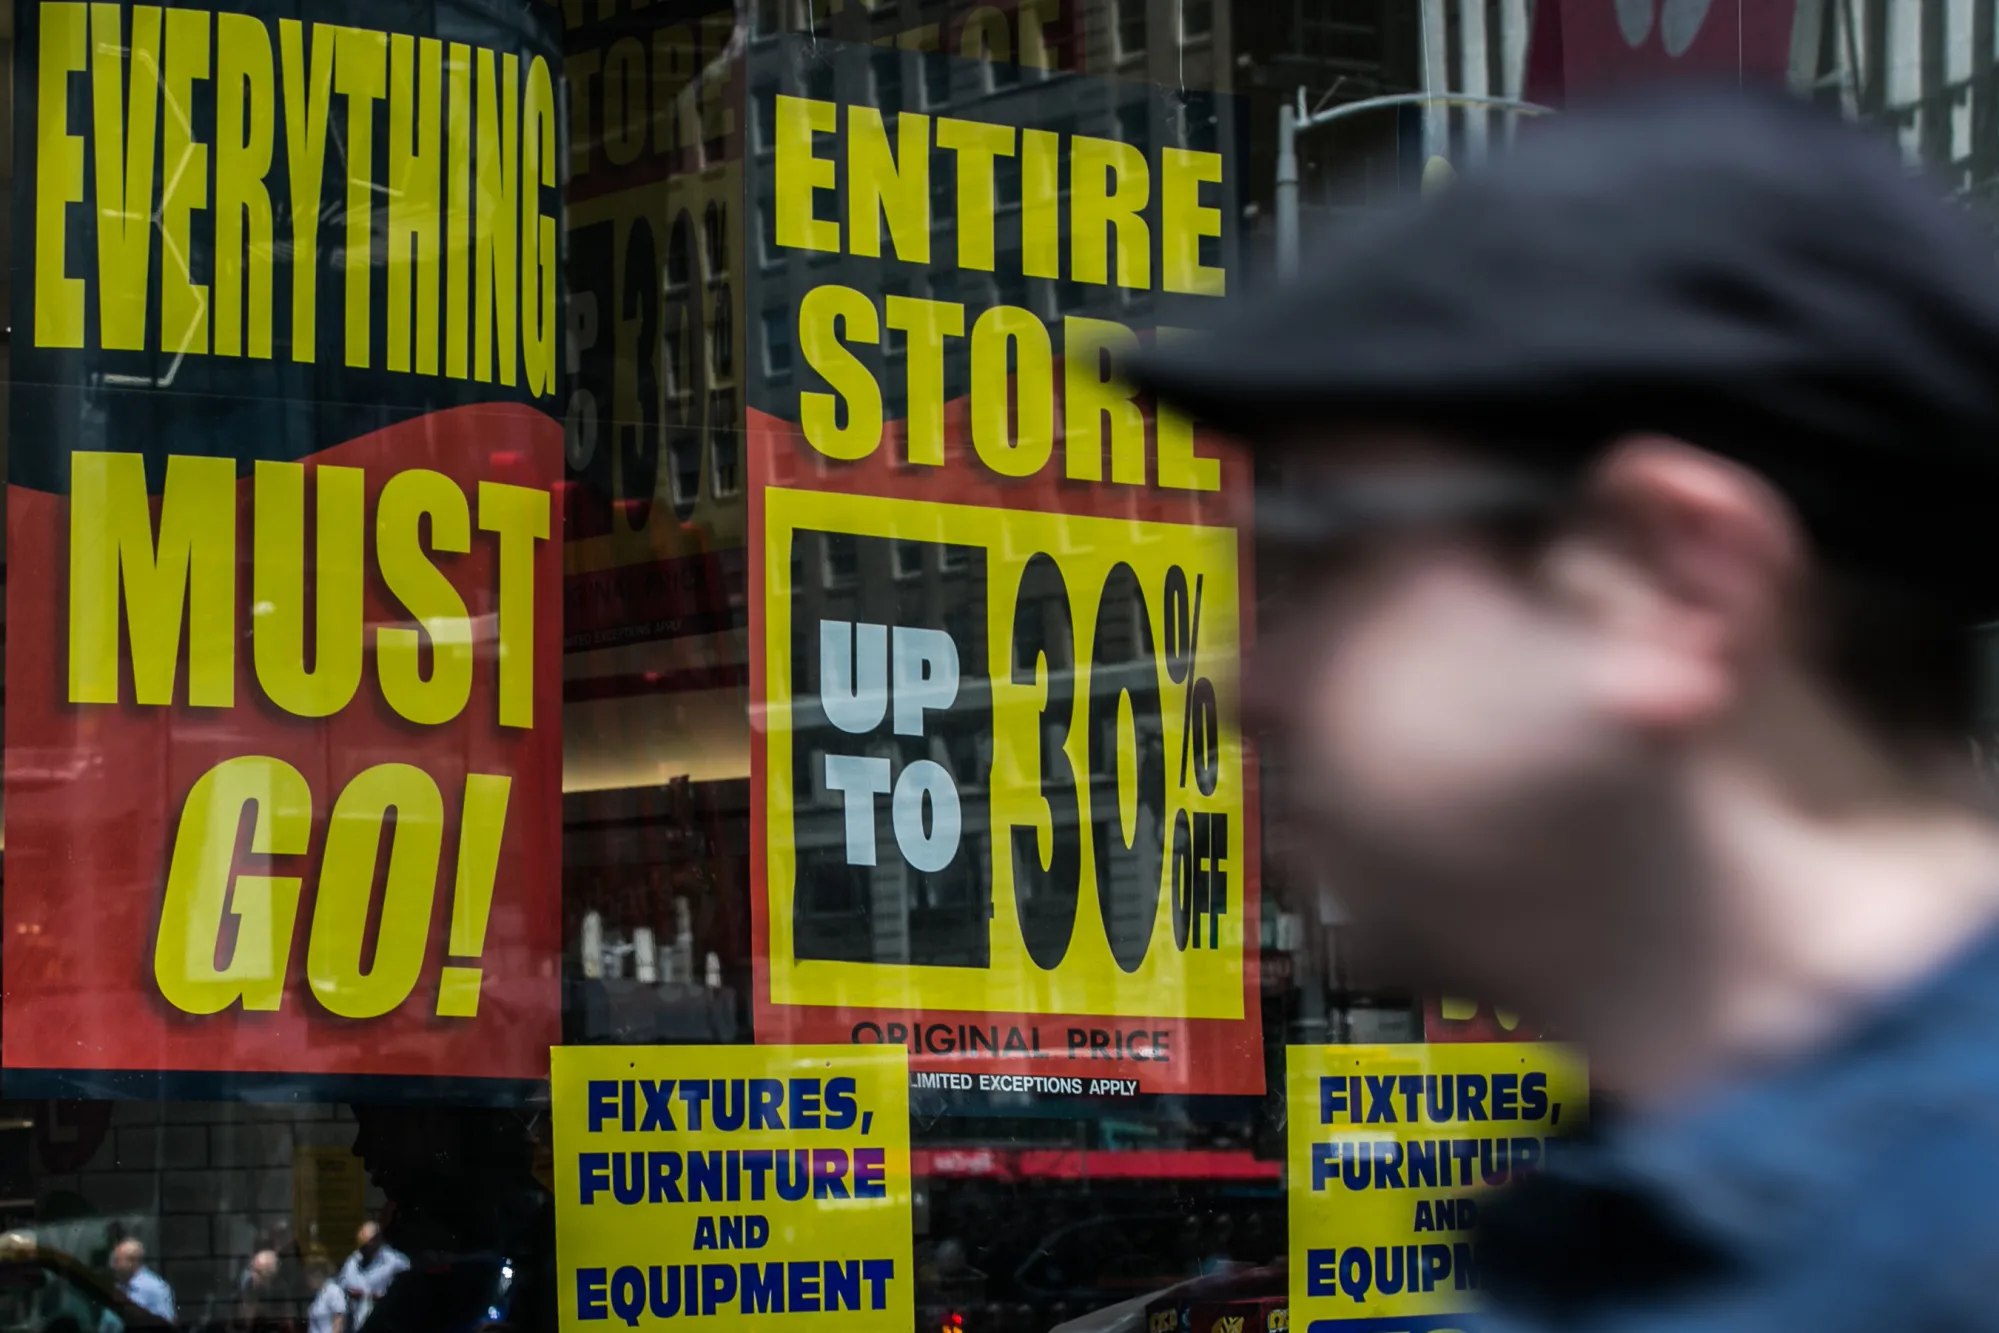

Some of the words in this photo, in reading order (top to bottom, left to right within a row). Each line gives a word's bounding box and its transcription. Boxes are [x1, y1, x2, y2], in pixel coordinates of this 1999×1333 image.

[564, 10, 735, 175] TORE
[34, 2, 557, 399] EVERYTHING
[775, 94, 1226, 299] ENTIRE
[799, 285, 1221, 492] STORE
[67, 450, 551, 729] MUST
[820, 620, 960, 737] UP
[825, 754, 962, 873] TO
[153, 755, 511, 1020] GO!
[1172, 808, 1228, 952] OFF
[852, 1022, 1049, 1058] ORIGINAL
[1067, 1028, 1171, 1063] PRICE
[979, 1075, 1083, 1095] EXCEPTIONS
[1088, 1079, 1138, 1097] APPLY
[588, 1077, 874, 1135] FIXTURES,
[1319, 1072, 1561, 1125] FIXTURES,
[578, 1148, 886, 1205] FURNITURE
[1311, 1137, 1552, 1192] FURNITUR
[693, 1215, 769, 1250] AND
[1413, 1199, 1478, 1232] AND
[576, 1259, 894, 1326] EQUIPMENT
